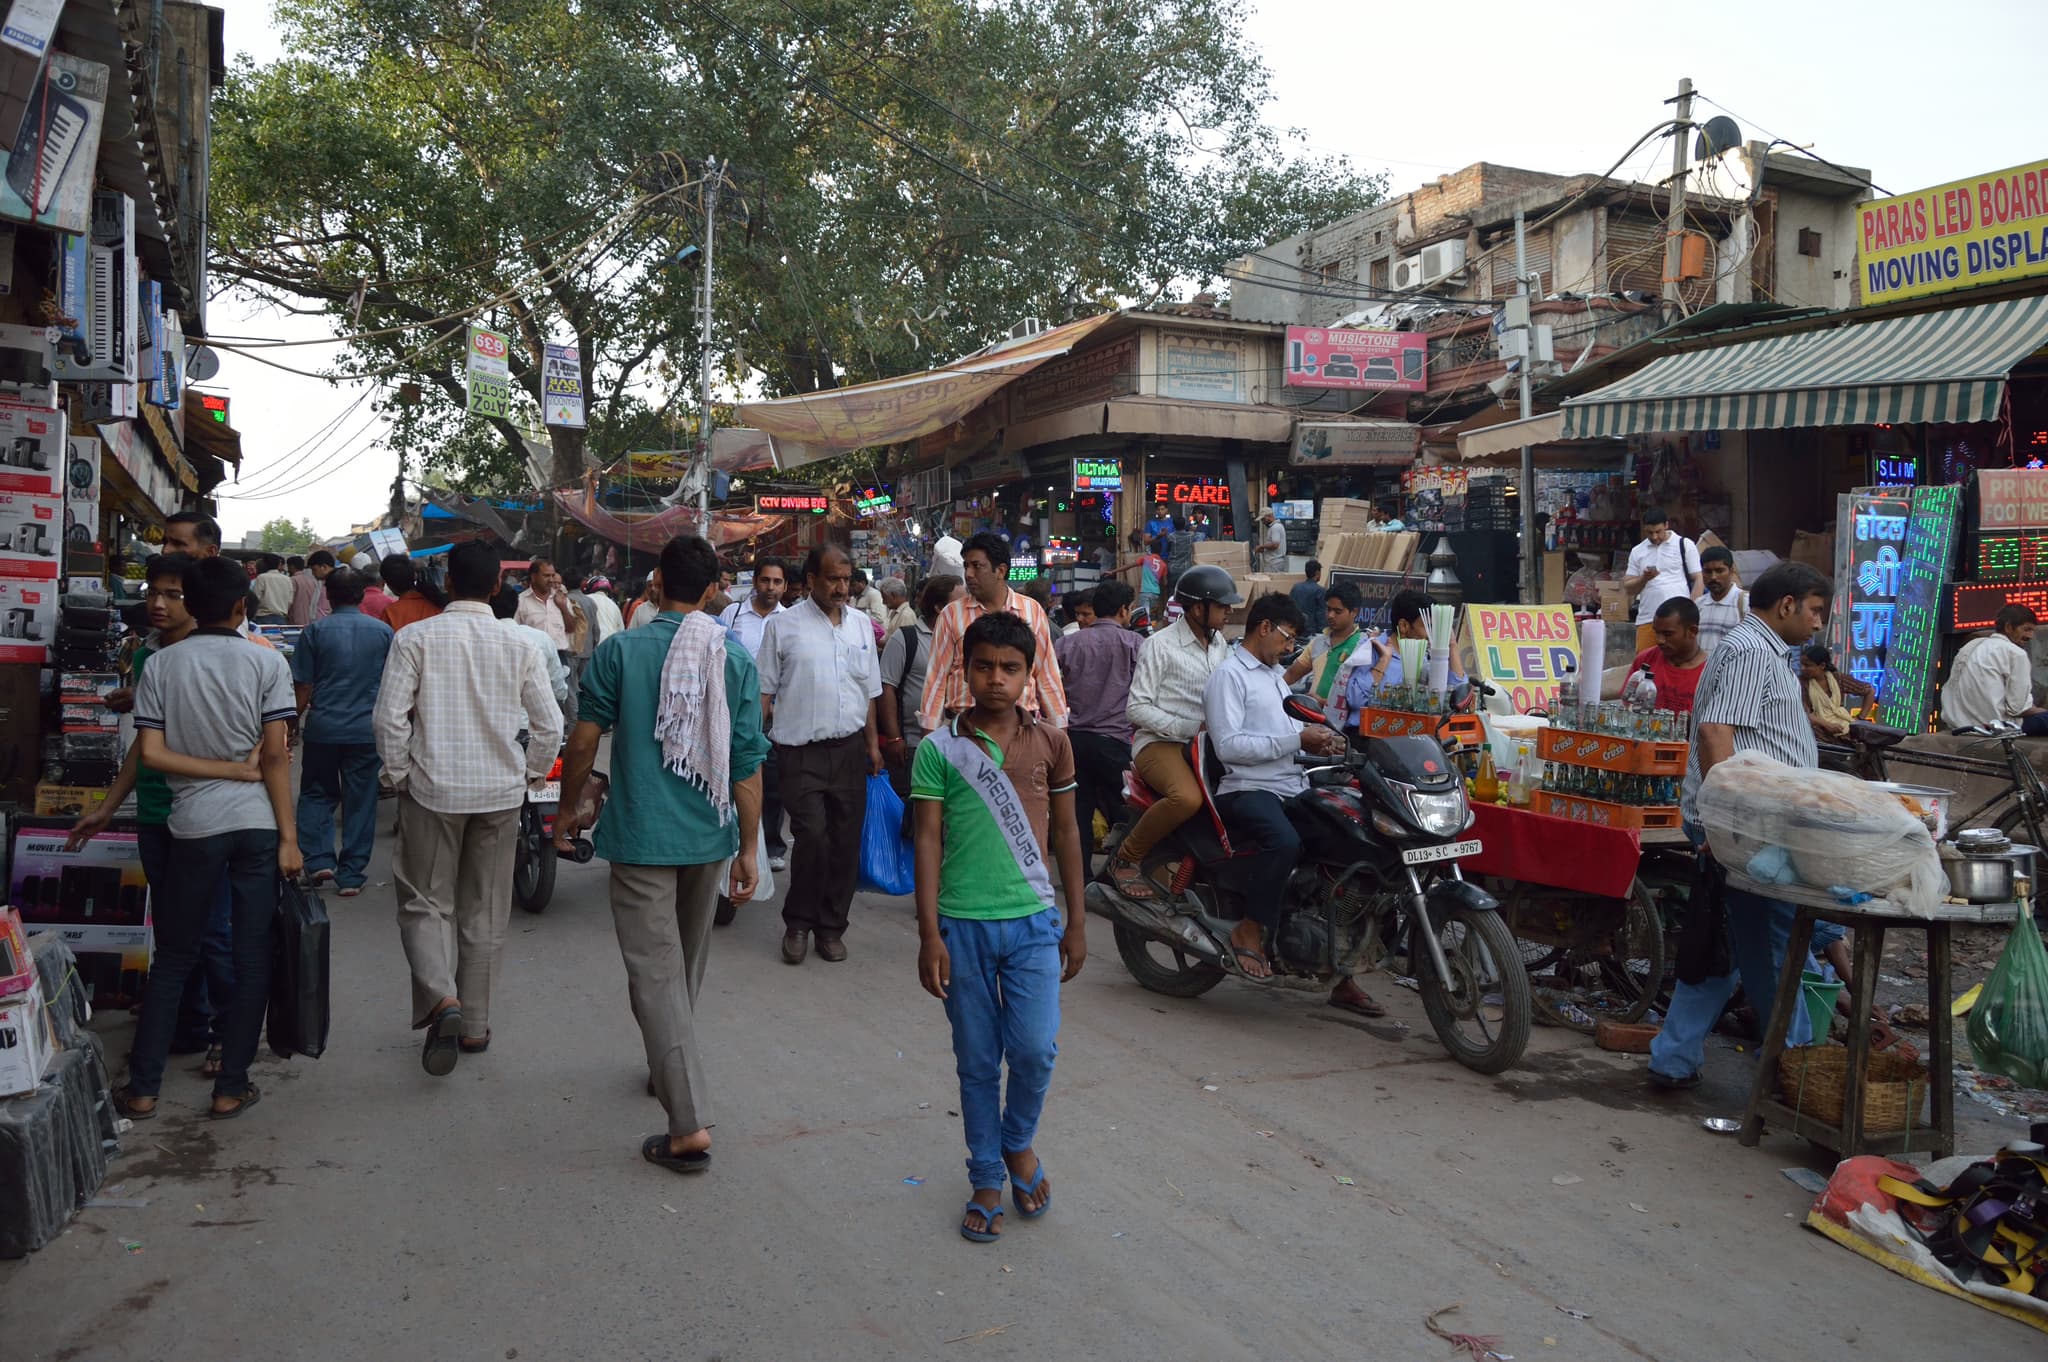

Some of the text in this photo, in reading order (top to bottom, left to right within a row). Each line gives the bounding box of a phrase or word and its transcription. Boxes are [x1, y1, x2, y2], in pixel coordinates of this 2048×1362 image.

[1863, 197, 1927, 252] PARAS
[1932, 186, 1973, 238] LED
[1868, 245, 1960, 293] MOVING
[475, 333, 504, 353] 639
[1328, 333, 1400, 347] MUSICTONE
[473, 382, 507, 399] CCTV
[547, 384, 580, 393] CCTV
[549, 377, 577, 386] DVR
[1879, 459, 1915, 478] SLIM
[759, 496, 828, 508] CCTV DIVINE EYE
[1155, 483, 1231, 504] E CARD
[1152, 558, 1160, 573] 5
[1856, 545, 1903, 597] श्री
[1479, 610, 1572, 641] PARAS
[1486, 645, 1580, 680] LED
[1552, 736, 1575, 753] Crush
[1577, 739, 1600, 758] Crush
[1602, 743, 1626, 761] Crush
[26, 843, 55, 852] MOVIE
[1460, 842, 1479, 854] 9767
